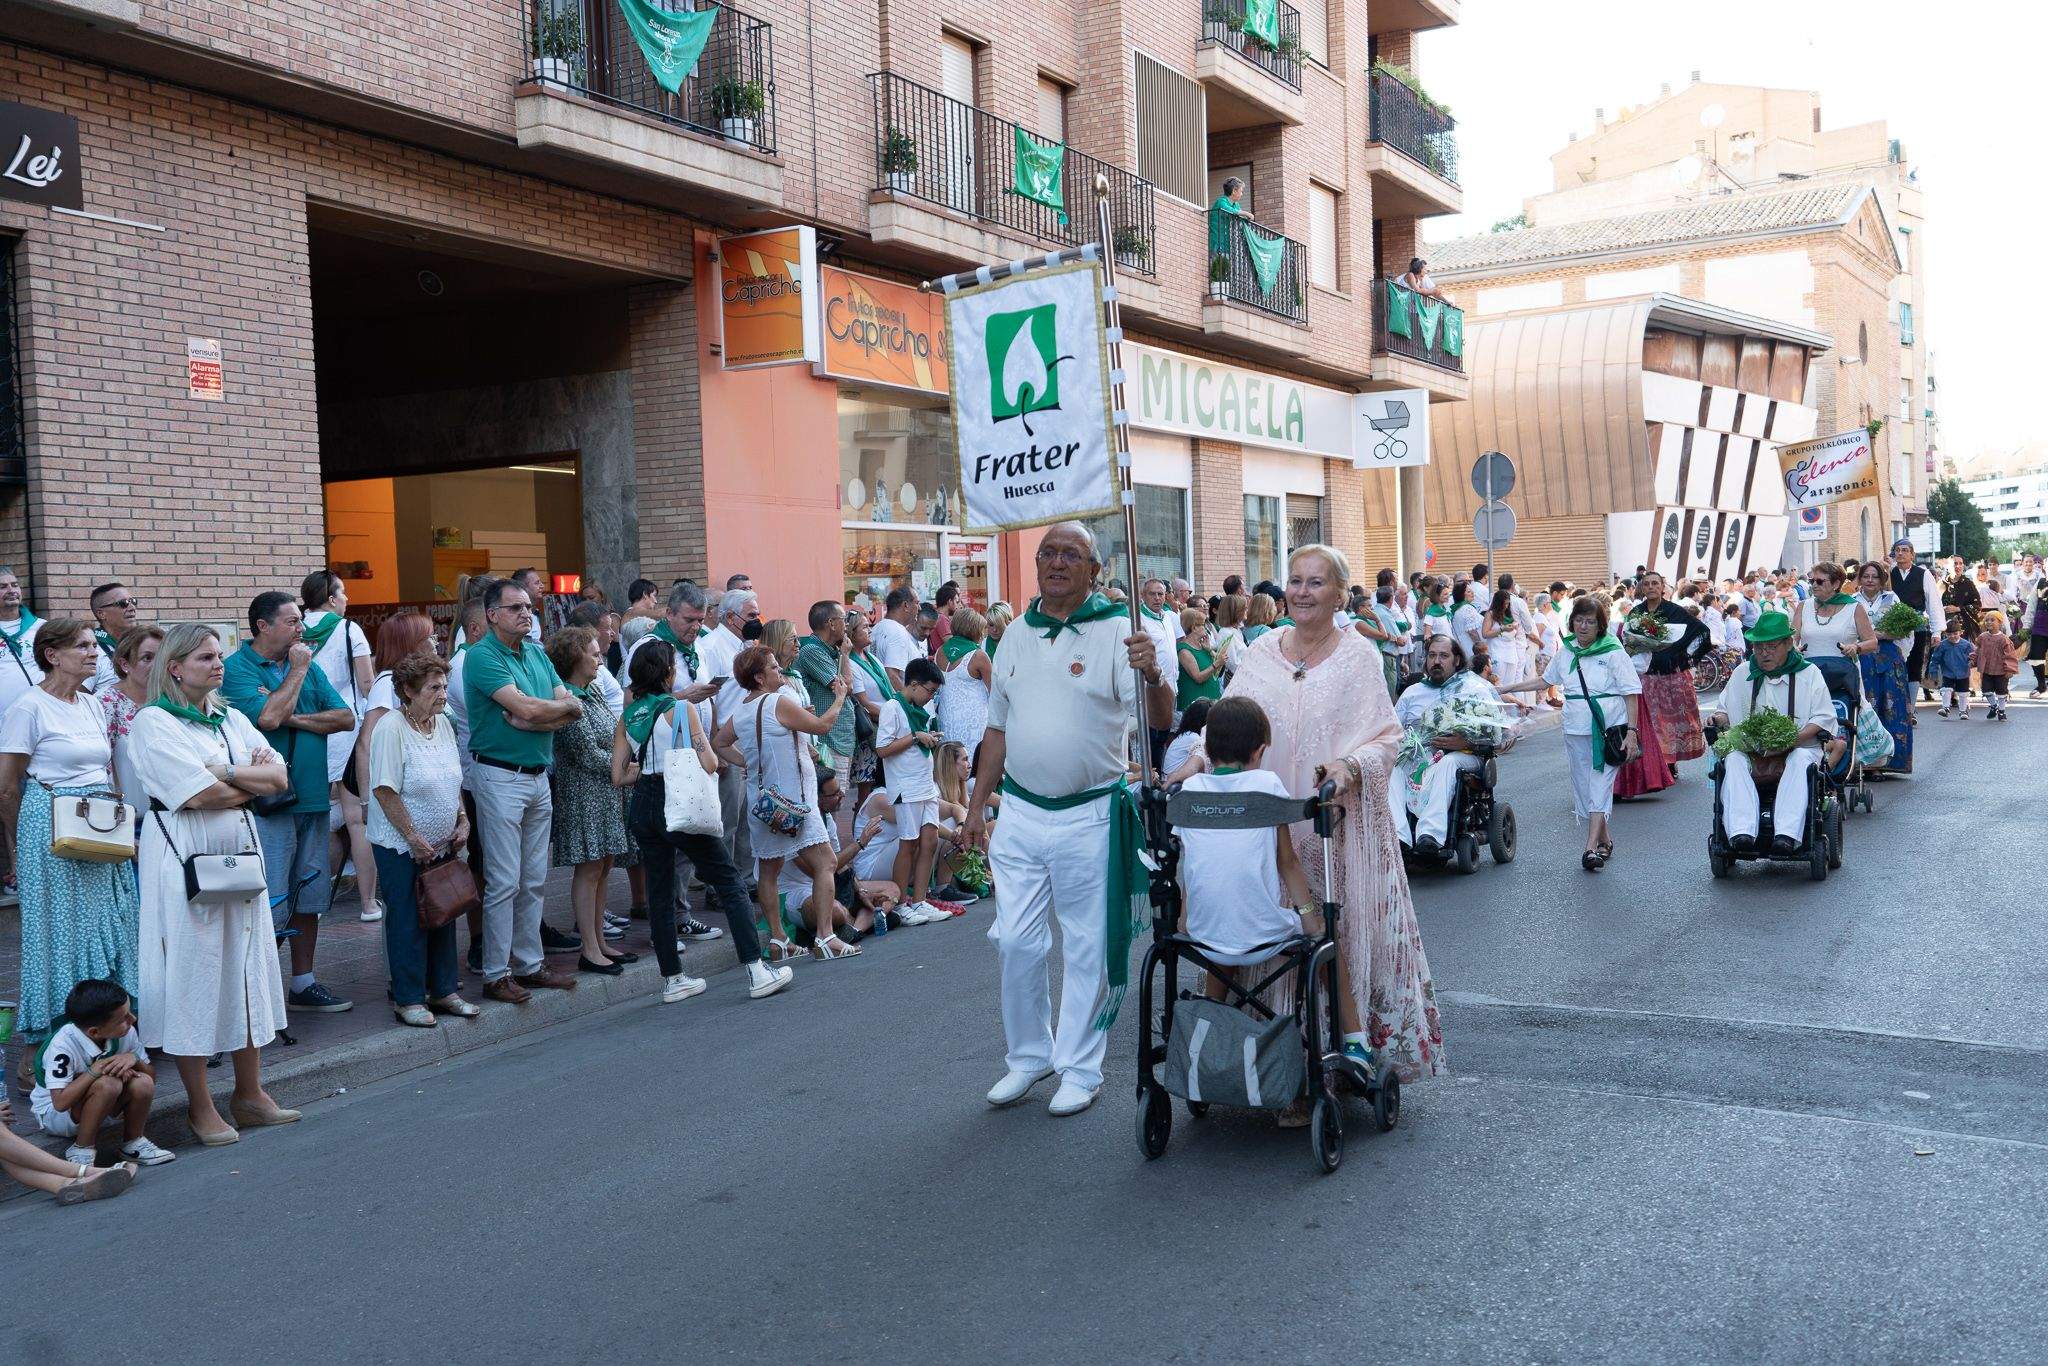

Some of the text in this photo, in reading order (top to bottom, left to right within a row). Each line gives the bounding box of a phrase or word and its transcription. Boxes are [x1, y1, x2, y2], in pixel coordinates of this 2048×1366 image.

[648, 19, 660, 30] San
[2, 134, 63, 187] Lei
[721, 273, 802, 306] Capricho
[826, 296, 930, 358] Capricho
[191, 363, 220, 372] Alarma
[1142, 353, 1304, 443] MICAELA
[1785, 435, 1861, 456] GRUPO FOLKLÓRICO
[974, 441, 1080, 484] Frater
[1003, 481, 1056, 499] Huesca
[1809, 478, 1874, 498] aragonés
[1191, 805, 1245, 815] Neptune
[52, 1053, 71, 1079] 3
